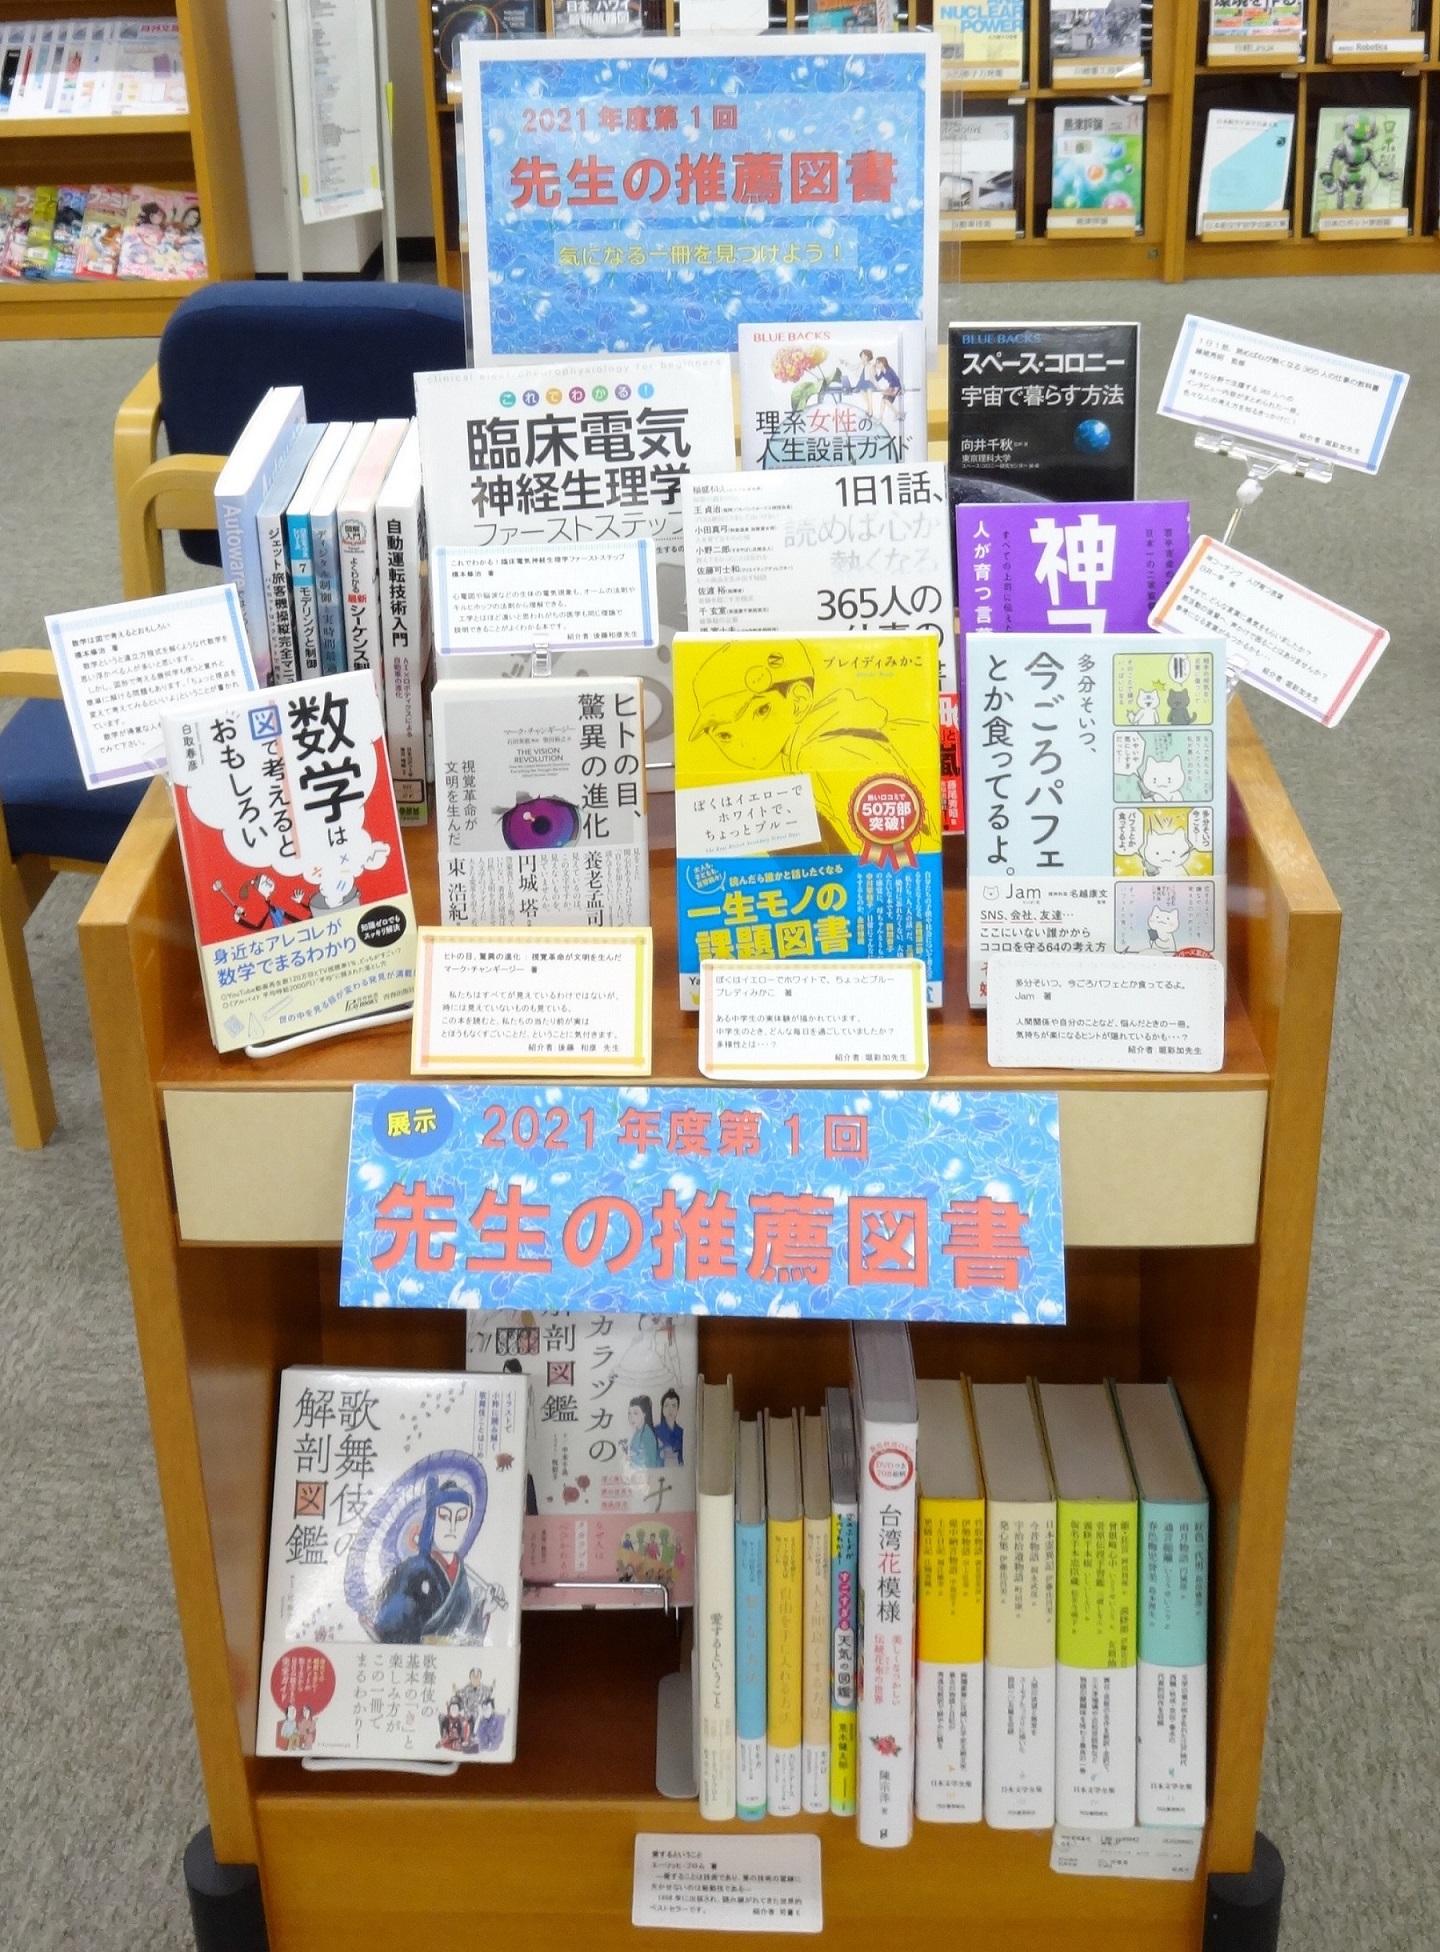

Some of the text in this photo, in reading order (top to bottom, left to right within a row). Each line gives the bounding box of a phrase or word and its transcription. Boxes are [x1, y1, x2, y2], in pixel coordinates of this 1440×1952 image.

[510, 149, 899, 209] 先生の推薦図書
[753, 331, 831, 342] BLUE BACKS
[962, 333, 1042, 345] BLUE BACKS
[961, 351, 1126, 375] スペース・コロニー
[961, 384, 1125, 407] 宇宙で暮らす方法
[466, 406, 692, 472] 臨床電気
[756, 408, 873, 435] 理系女性の
[756, 436, 913, 464] 人生設計ガイド
[961, 438, 1014, 452] 向井千秋
[470, 461, 692, 519] 神経生理学
[223, 503, 247, 589] Autoware
[299, 563, 307, 574] 7
[387, 519, 409, 648] 自動運転技術入門
[973, 520, 994, 634] 人が育つ言
[347, 594, 368, 604] 最新
[817, 584, 943, 622] 365人の
[299, 586, 318, 670] モデリングと制御
[823, 654, 924, 671] ブレイディみかこ
[287, 690, 365, 848] 数学は
[513, 755, 564, 764] REVOLUTION
[517, 747, 560, 756] THE VISION
[577, 693, 610, 840] 驚異の進化
[613, 692, 642, 818] ヒトの目、
[981, 653, 1016, 878] とか食ってるよ。
[1023, 650, 1066, 869] 今ごろパフェ
[210, 712, 268, 850] おもしろい
[248, 703, 298, 860] 図で考えると
[461, 759, 478, 832] 視覚革命が
[693, 785, 804, 813] ぼくはイエローで
[444, 760, 462, 847] 文明を生んだ
[861, 801, 912, 818] 50万部
[705, 818, 799, 843] ちょっとブルー
[687, 882, 849, 926] 一生モノの
[1005, 883, 1109, 900] Jam 名越康文
[213, 917, 343, 967] 身近なアレコレが
[695, 915, 853, 962] 課題図書
[980, 926, 1092, 940] ここにいない誰かから
[980, 941, 1107, 954] ココロを守る64の考え方
[216, 936, 357, 988] 数学でまるわかり
[1014, 991, 1052, 1001] Jam 著
[528, 1043, 553, 1053] 紹介者
[834, 1053, 860, 1062] 紹介者
[1127, 1045, 1153, 1055] 紹介者
[386, 1107, 438, 1137] 展示
[369, 1180, 1030, 1292] 先生の推薦図書
[285, 1386, 337, 1566] 解剖図鑑
[876, 1504, 903, 1624] 台湾花模様
[421, 1652, 438, 1718] 歌舞伎の
[837, 1634, 852, 1700] 天気の図鑑
